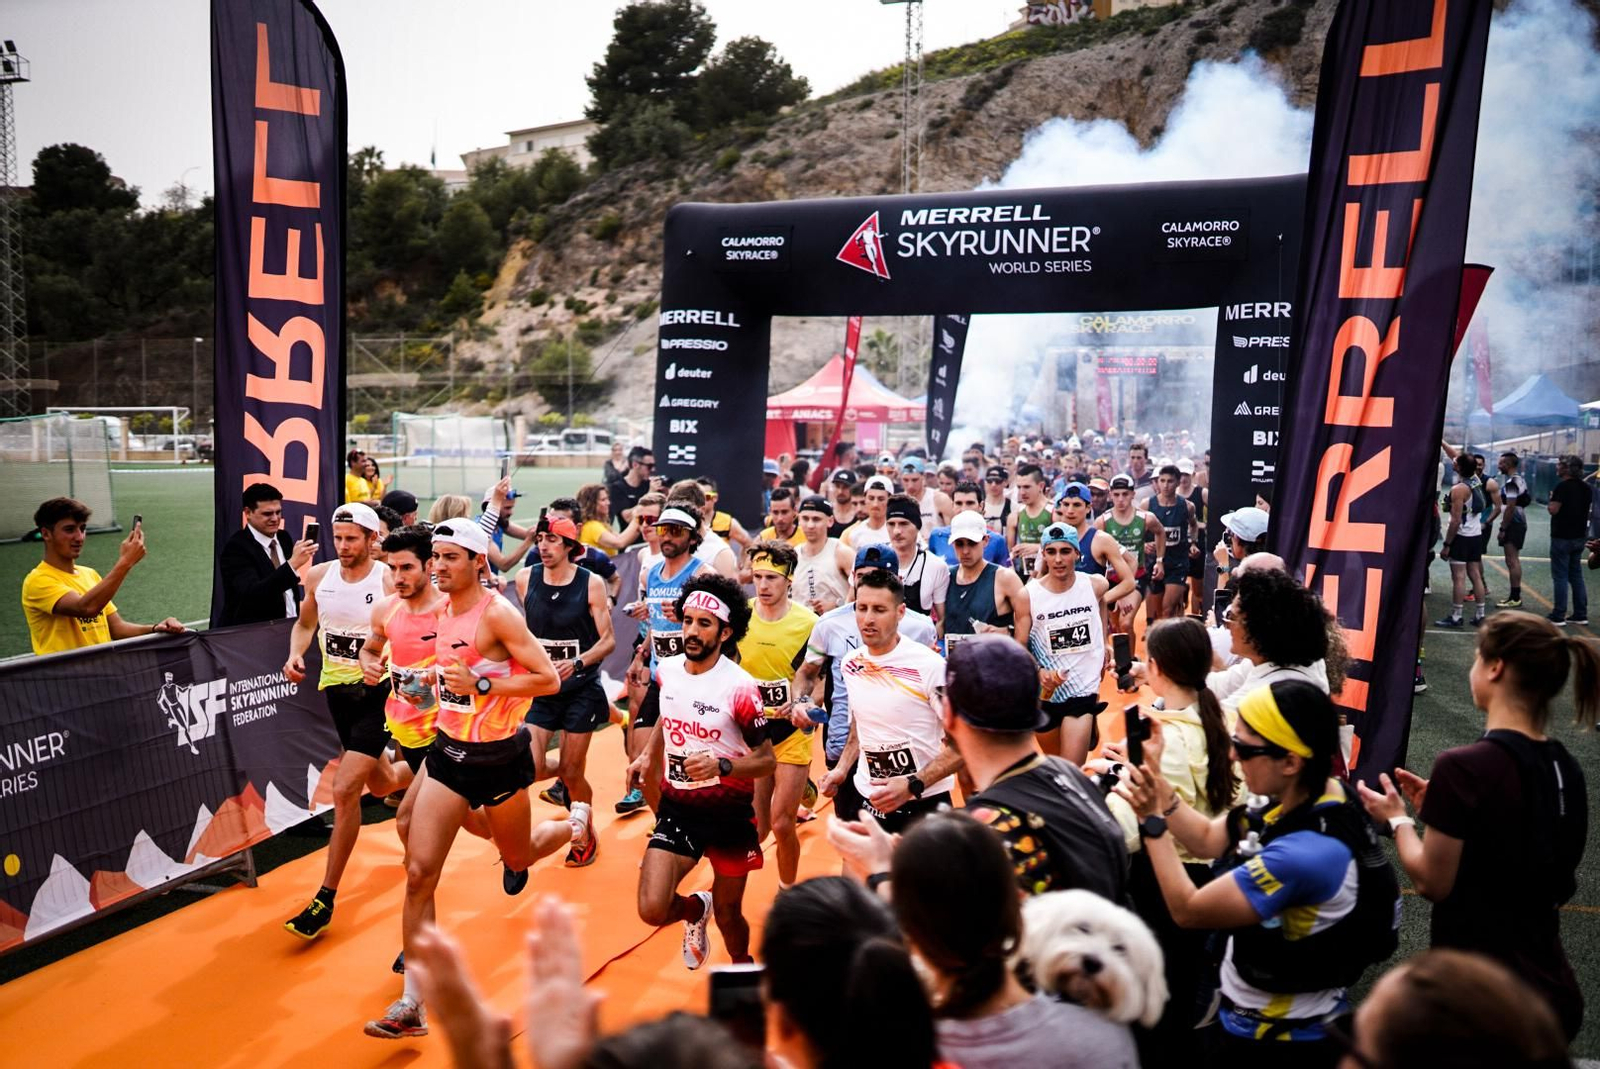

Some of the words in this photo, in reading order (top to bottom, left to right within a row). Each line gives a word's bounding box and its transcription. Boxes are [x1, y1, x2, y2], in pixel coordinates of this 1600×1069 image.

[900, 204, 1051, 226] MERRELL
[1161, 220, 1240, 233] CALAMORRO
[721, 236, 784, 247] CALAMORRO
[988, 261, 1040, 274] WORLD
[1045, 259, 1092, 273] SERIES
[669, 338, 728, 351] PRESSIO
[677, 367, 713, 379] deuter
[1303, 0, 1447, 769] ERRELL
[670, 398, 720, 409] GREGORY
[669, 419, 699, 433] BIX
[688, 592, 720, 611] AID
[1047, 605, 1092, 620] SCARPA
[1072, 626, 1088, 641] 42
[349, 639, 358, 653] 4
[669, 638, 678, 651] 6
[562, 646, 569, 659] 1
[229, 671, 289, 695] INTERNATIONAL
[231, 682, 299, 712] SKYRUNNING
[766, 687, 784, 701] 13
[232, 703, 278, 728] FEDERATION
[662, 717, 721, 746] ozalbo
[887, 750, 909, 769] 10
[0, 770, 38, 798] RIES
